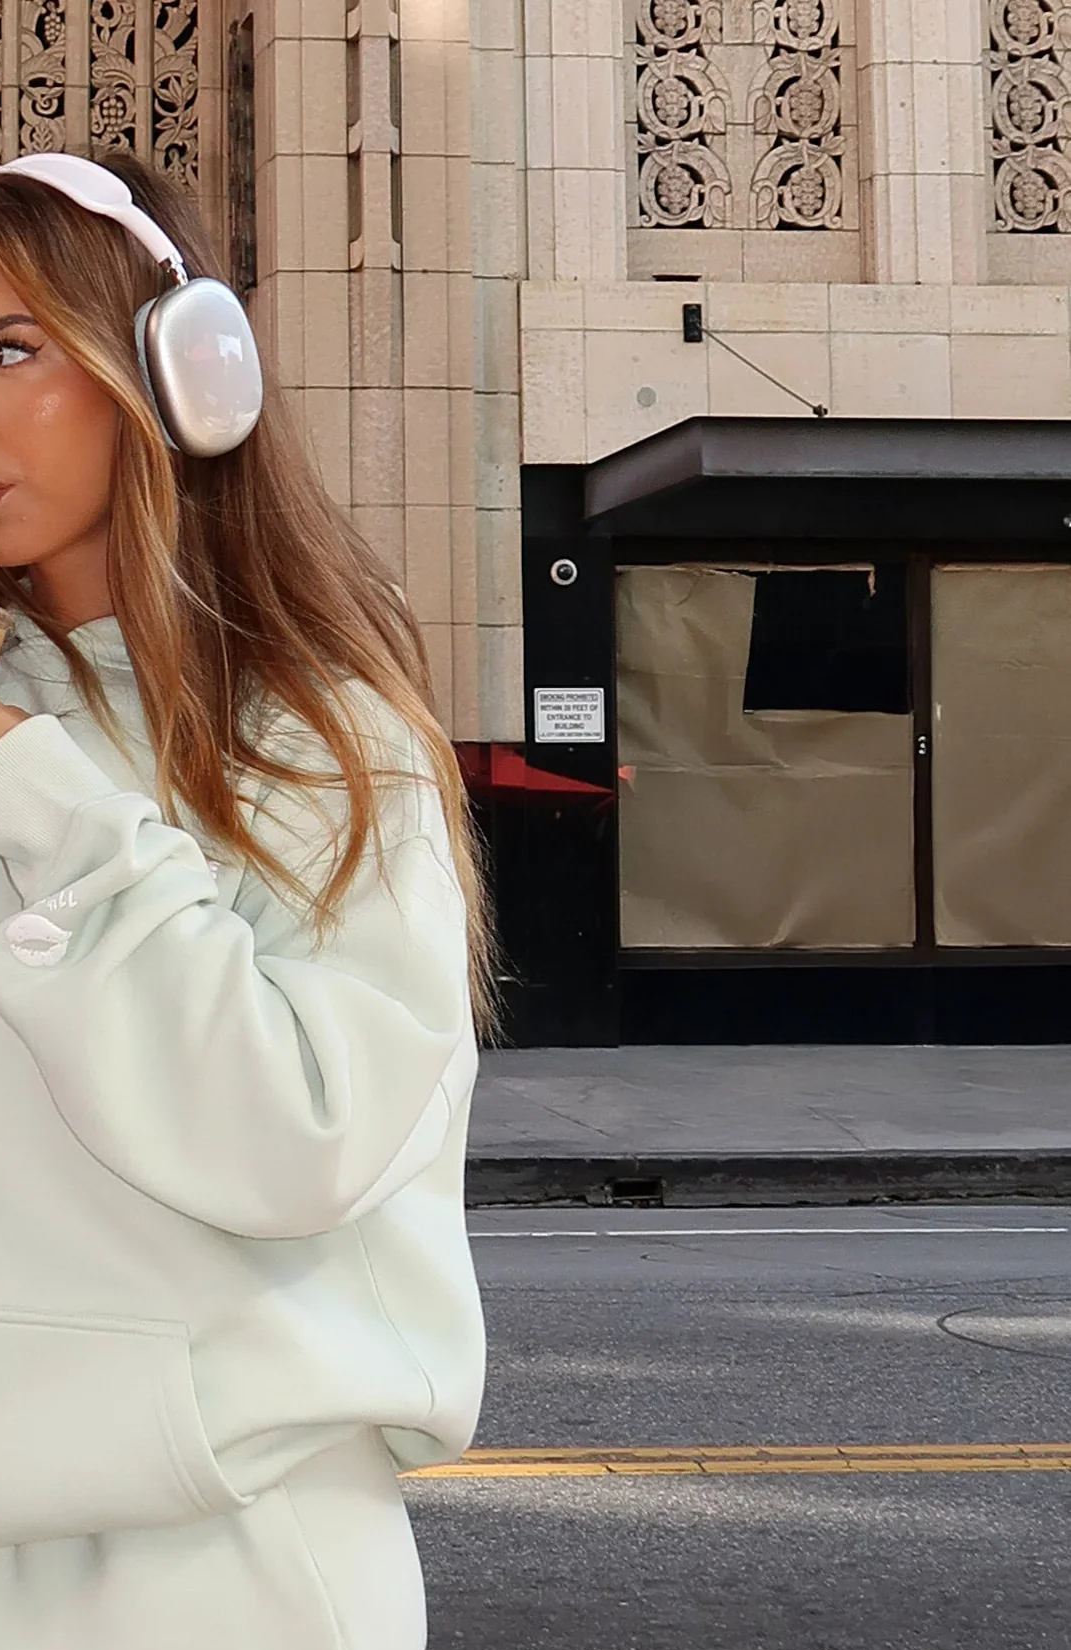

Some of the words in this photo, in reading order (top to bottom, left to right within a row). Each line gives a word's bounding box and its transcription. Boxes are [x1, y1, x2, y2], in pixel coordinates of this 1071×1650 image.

[546, 713, 581, 721] ENTRANCE
[583, 713, 592, 721] TO
[554, 722, 585, 730] BUILDING
